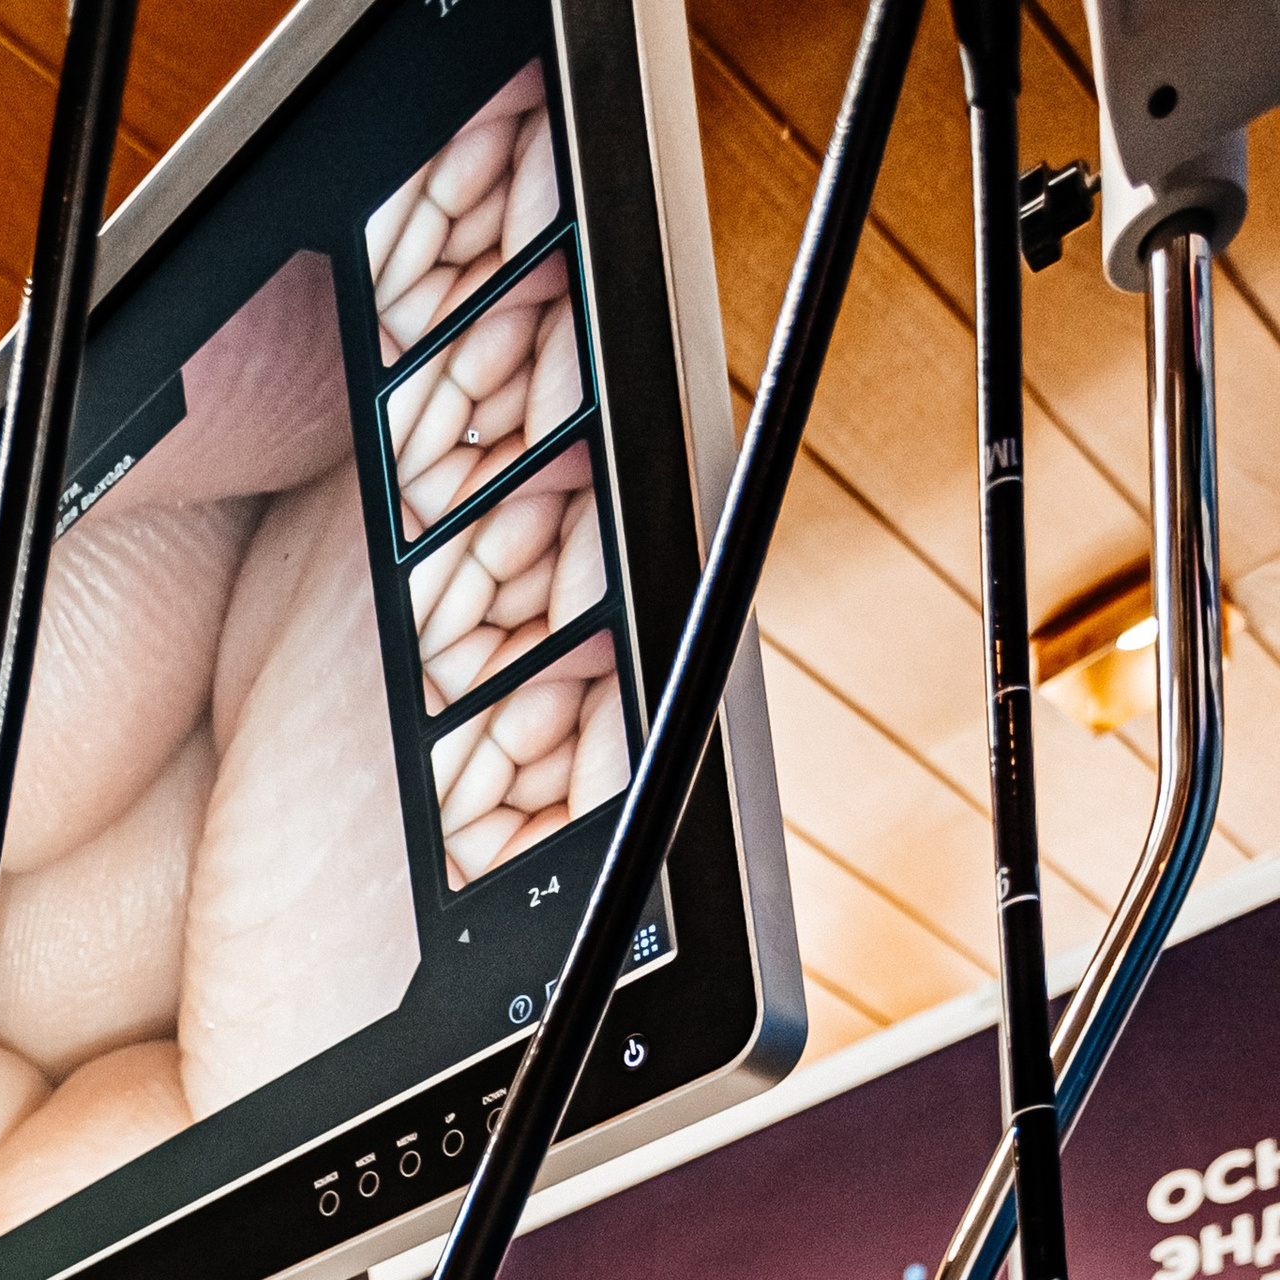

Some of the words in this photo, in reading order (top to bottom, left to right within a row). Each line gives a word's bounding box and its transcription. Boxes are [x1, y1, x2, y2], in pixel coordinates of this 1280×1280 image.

[527, 875, 561, 908] 2-4
[482, 1087, 507, 1106] DOWN
[445, 1112, 456, 1124] UP
